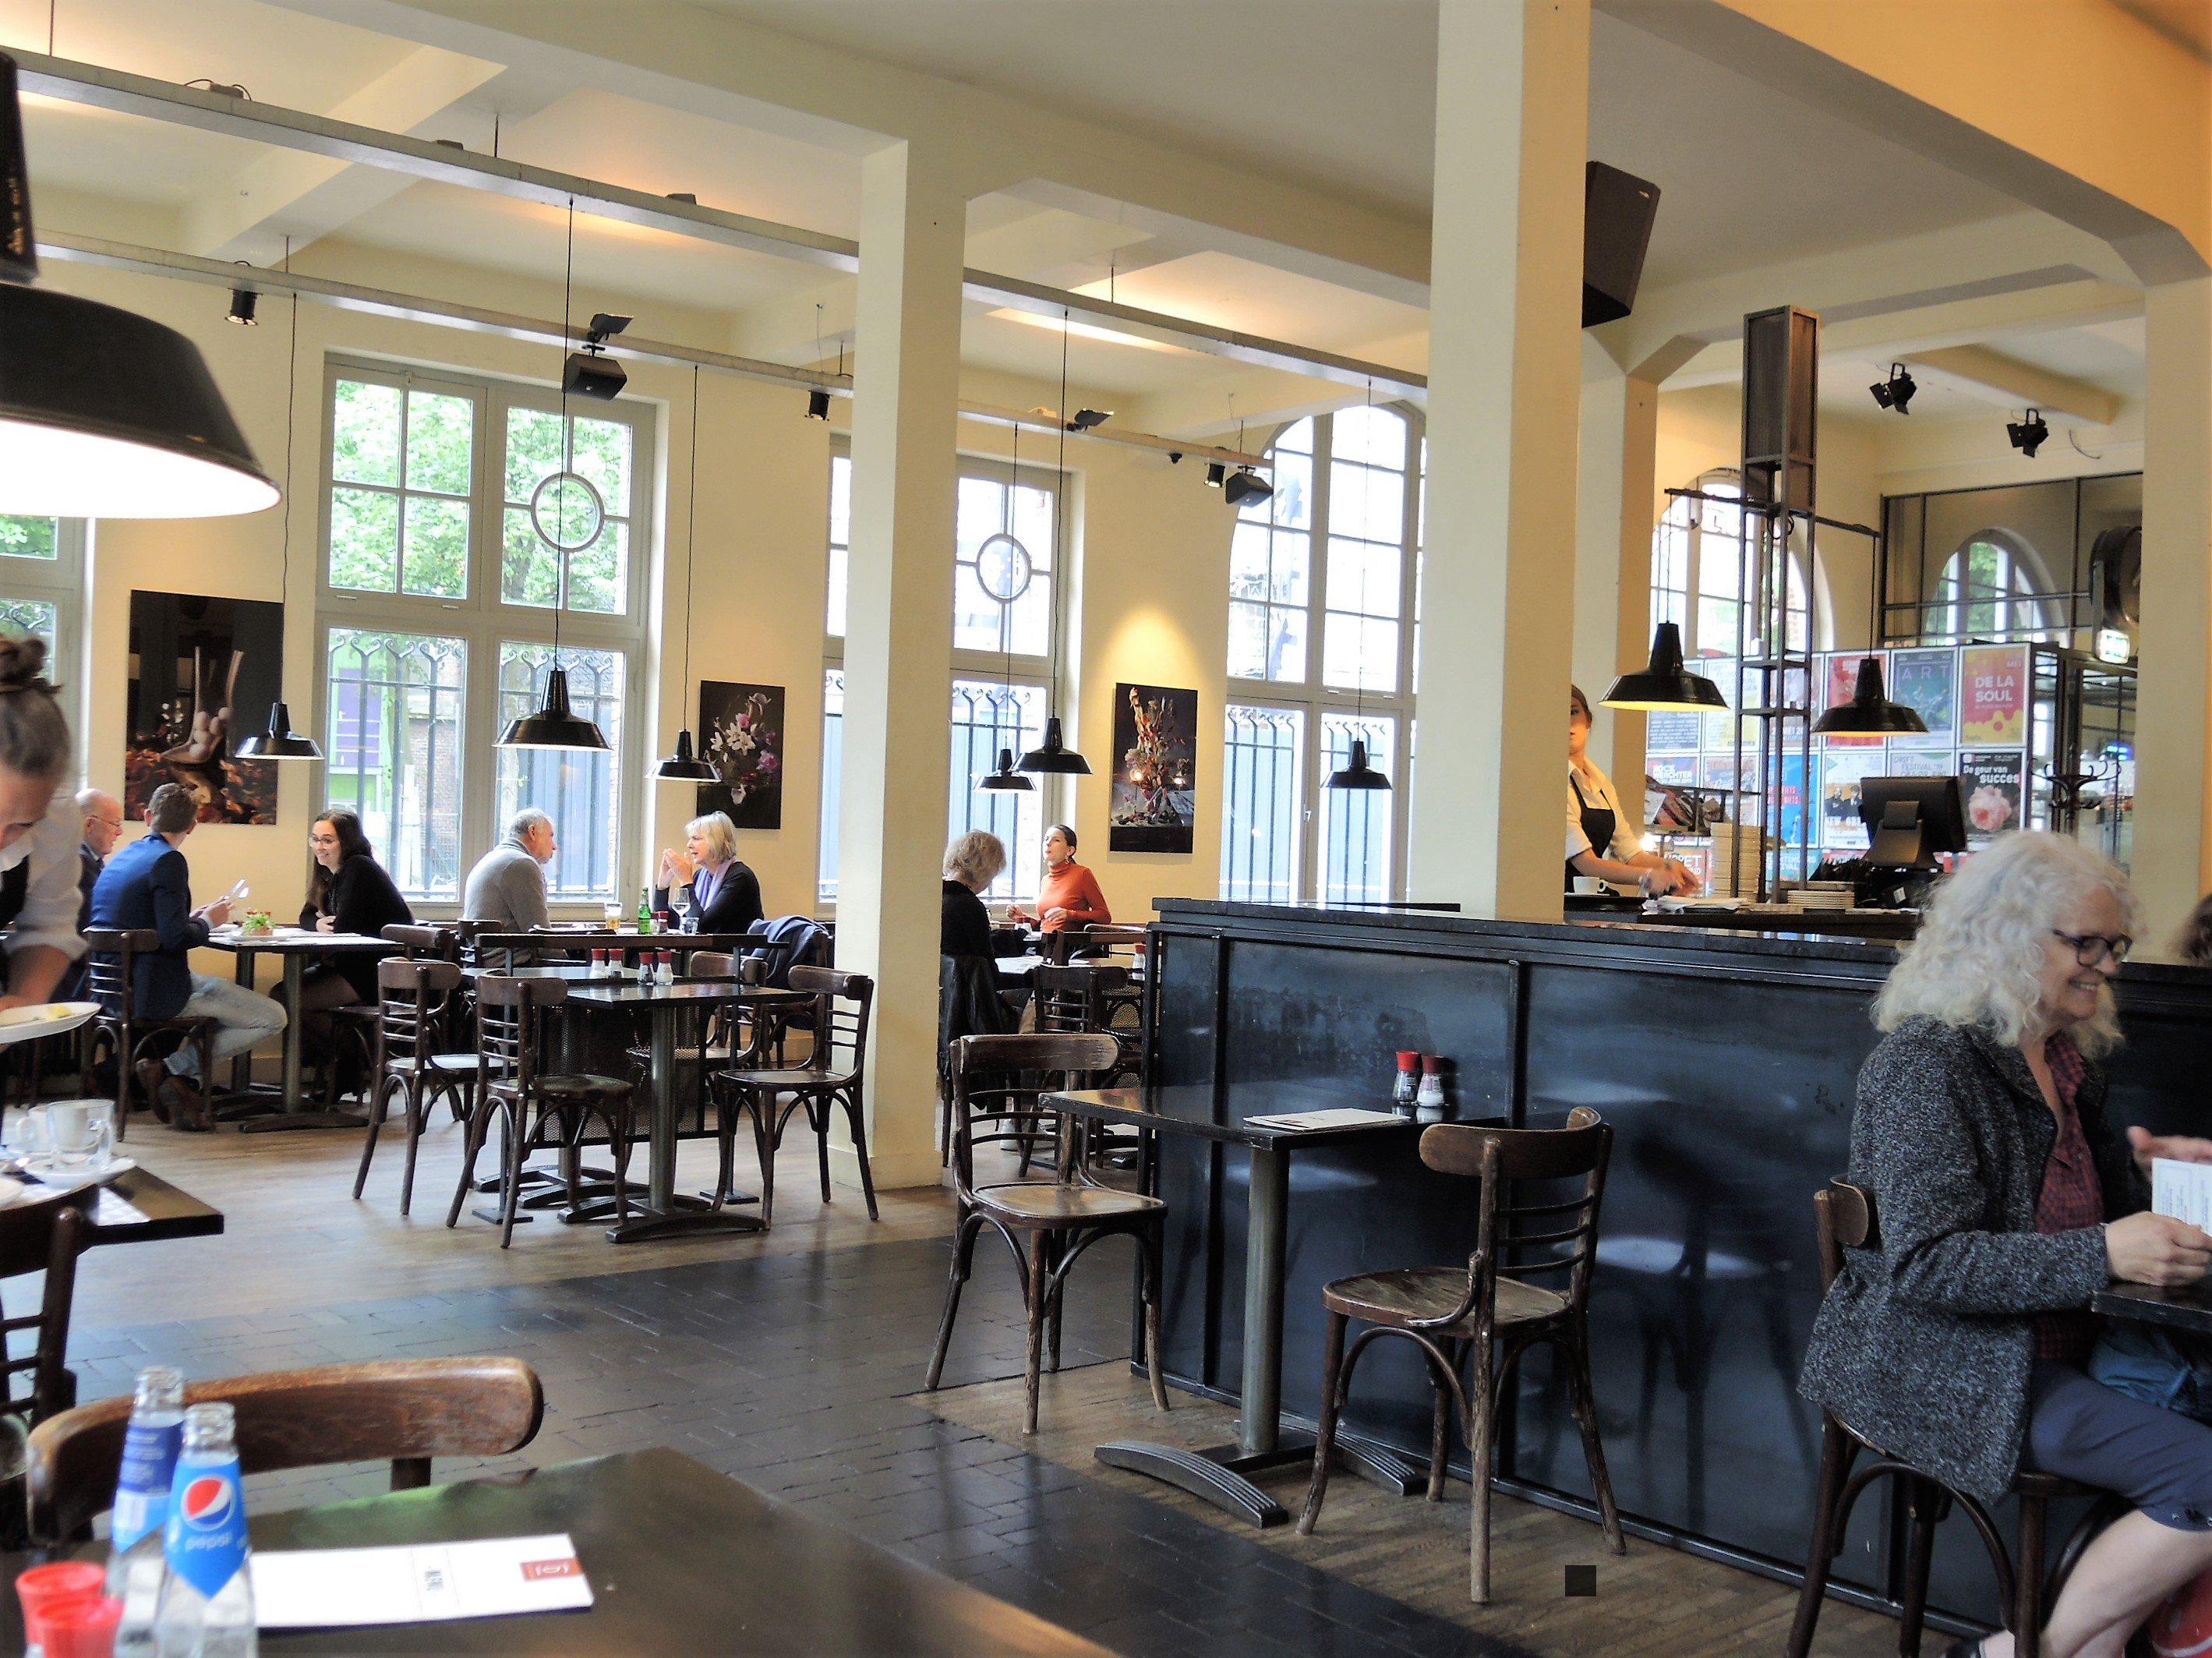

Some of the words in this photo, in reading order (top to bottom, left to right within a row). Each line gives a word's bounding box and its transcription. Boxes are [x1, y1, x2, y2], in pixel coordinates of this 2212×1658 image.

[1975, 675, 1994, 689] DE
[1996, 675, 2015, 687] LA
[1975, 689, 2013, 702] SOUL
[1963, 765, 1973, 773] De
[1974, 766, 1992, 776] geur
[184, 1533, 231, 1551] pepsi
